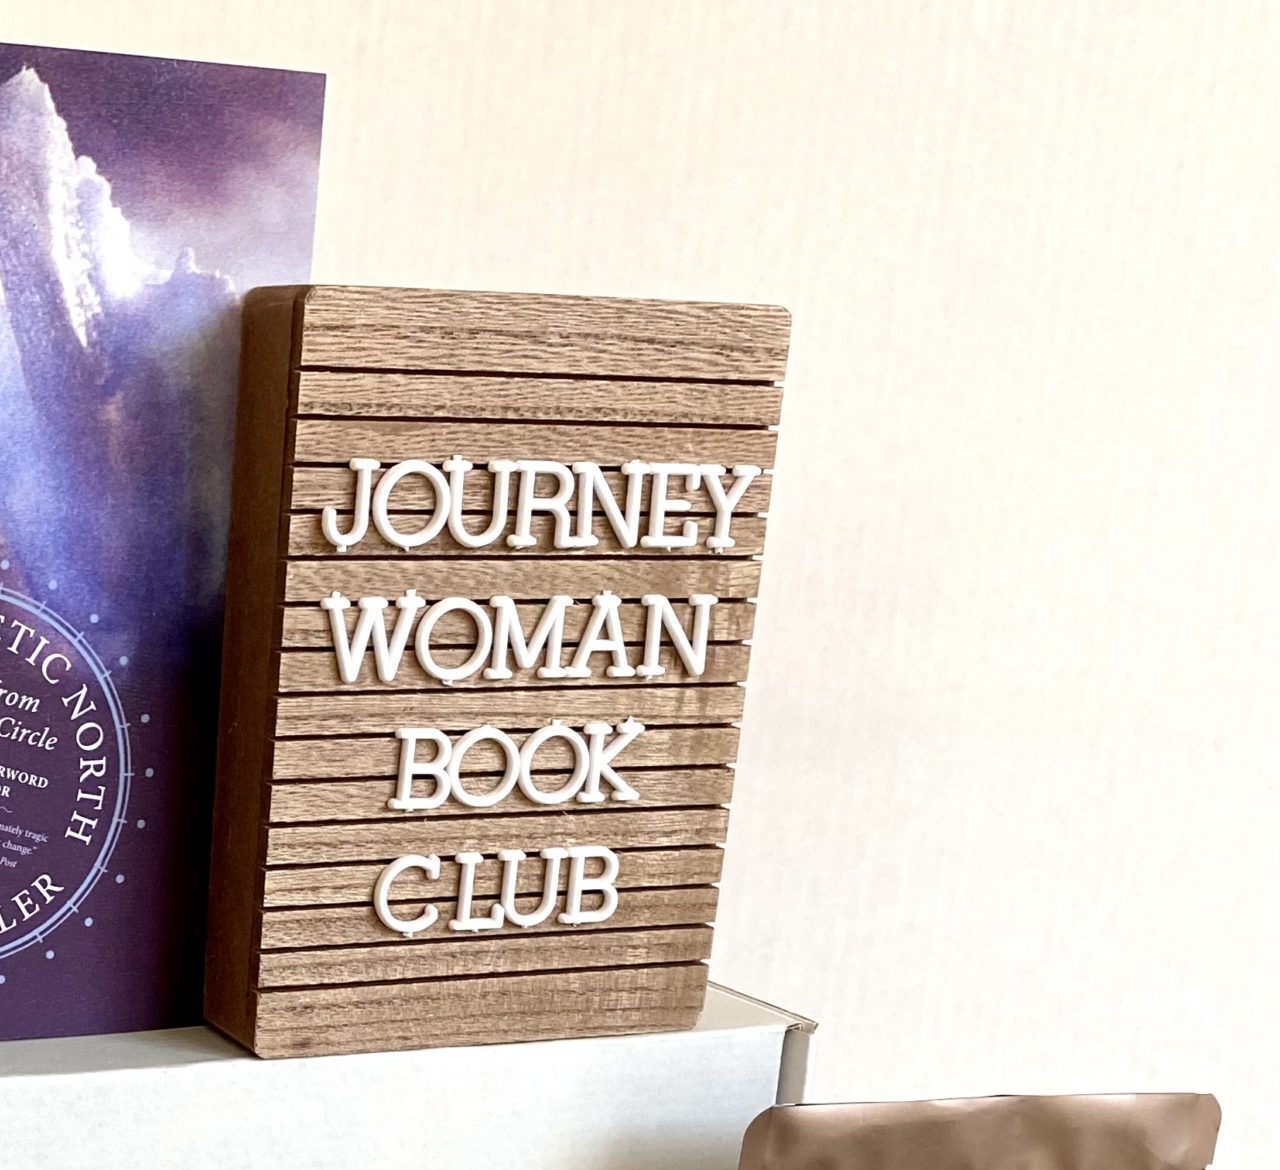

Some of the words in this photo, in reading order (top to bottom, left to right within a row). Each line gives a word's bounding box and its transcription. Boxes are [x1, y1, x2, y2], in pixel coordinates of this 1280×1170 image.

[321, 455, 763, 554] JOURNEY
[321, 589, 718, 687] WOMAN
[62, 684, 108, 847] NORTH
[387, 716, 645, 812] BOOK
[0, 856, 18, 868] Post
[24, 829, 49, 843] tragic
[373, 845, 620, 937] CLUB
